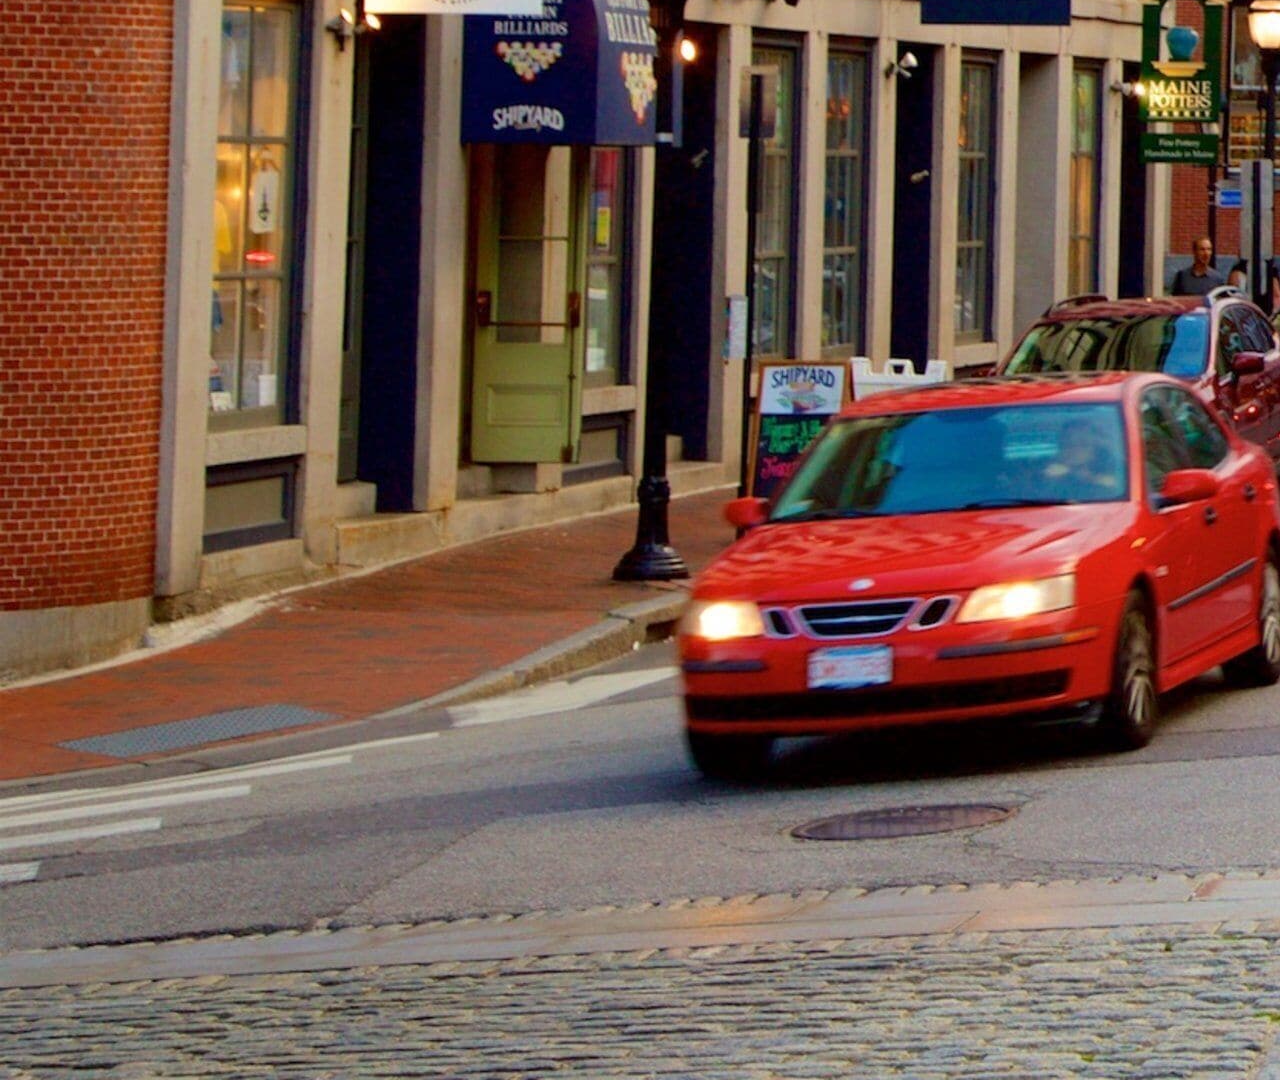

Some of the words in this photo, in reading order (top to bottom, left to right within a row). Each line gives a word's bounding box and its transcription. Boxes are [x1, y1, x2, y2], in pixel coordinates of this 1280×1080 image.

[494, 21, 569, 37] BILLIARDS
[1148, 80, 1213, 96] MAINE
[1148, 94, 1212, 109] POTTERS
[492, 104, 565, 131] SHIPYARD
[771, 366, 836, 389] SHIPYARD
